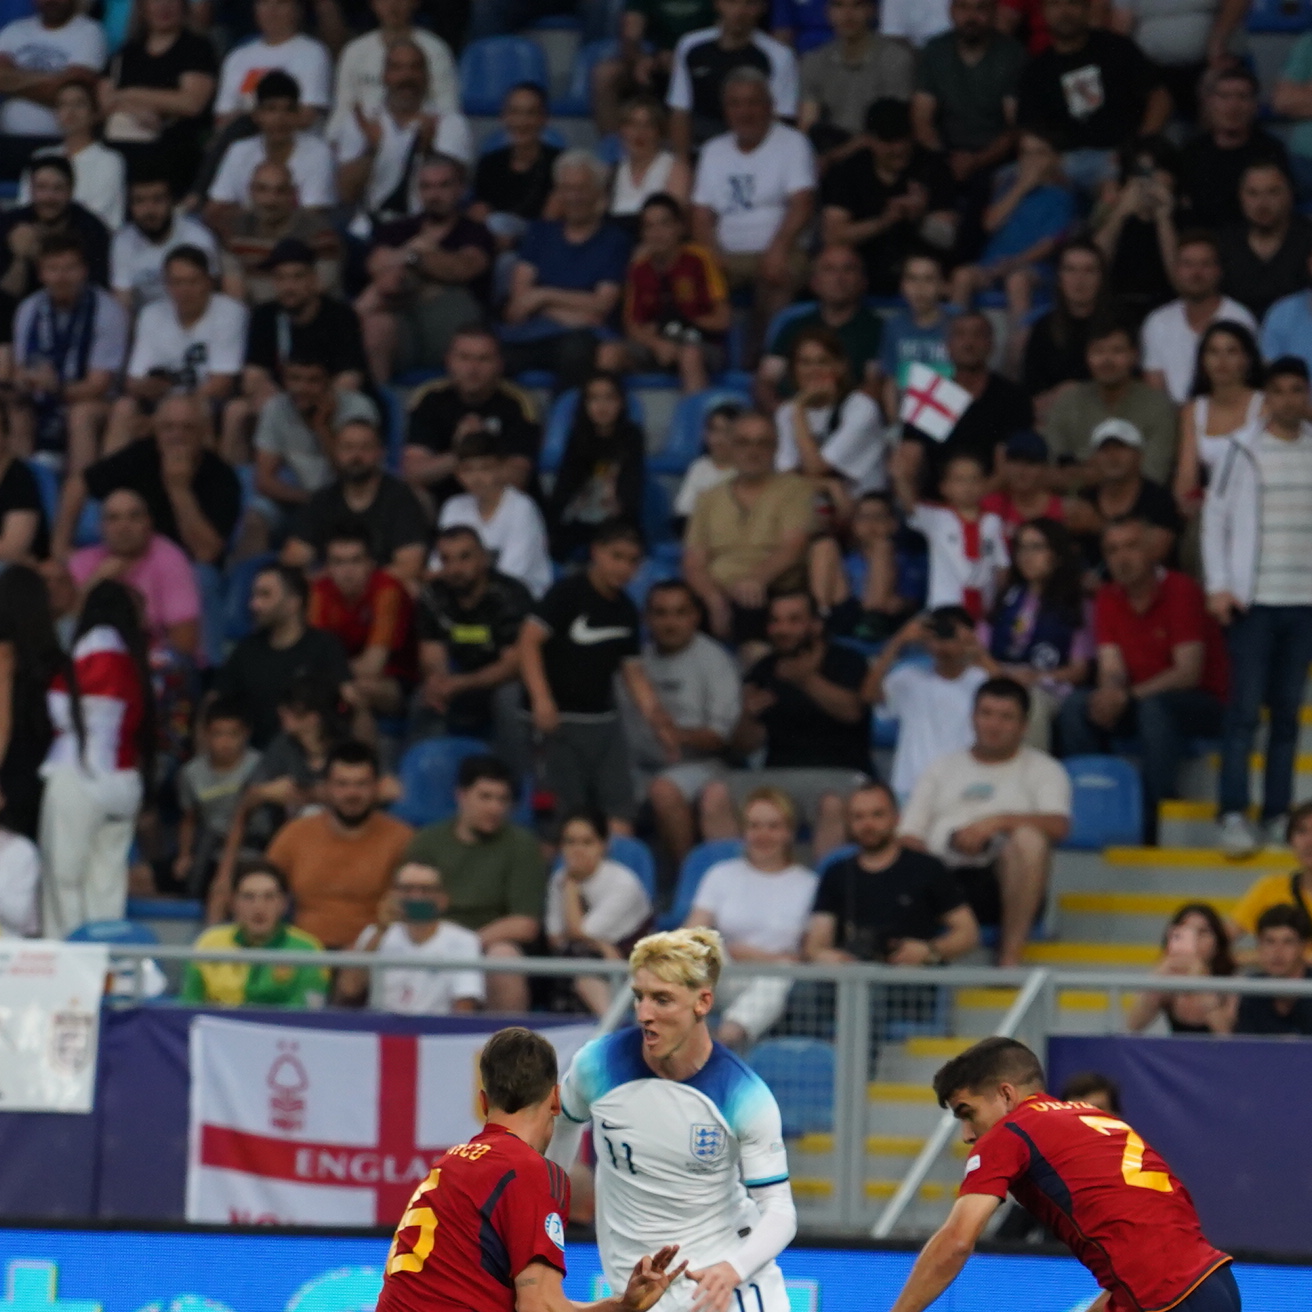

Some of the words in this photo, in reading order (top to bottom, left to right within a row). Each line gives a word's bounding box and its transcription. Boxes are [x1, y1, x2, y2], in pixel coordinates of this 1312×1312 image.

[295, 1147, 442, 1184] ENGLA
[604, 1136, 638, 1175] 11
[1078, 1115, 1174, 1193] 2
